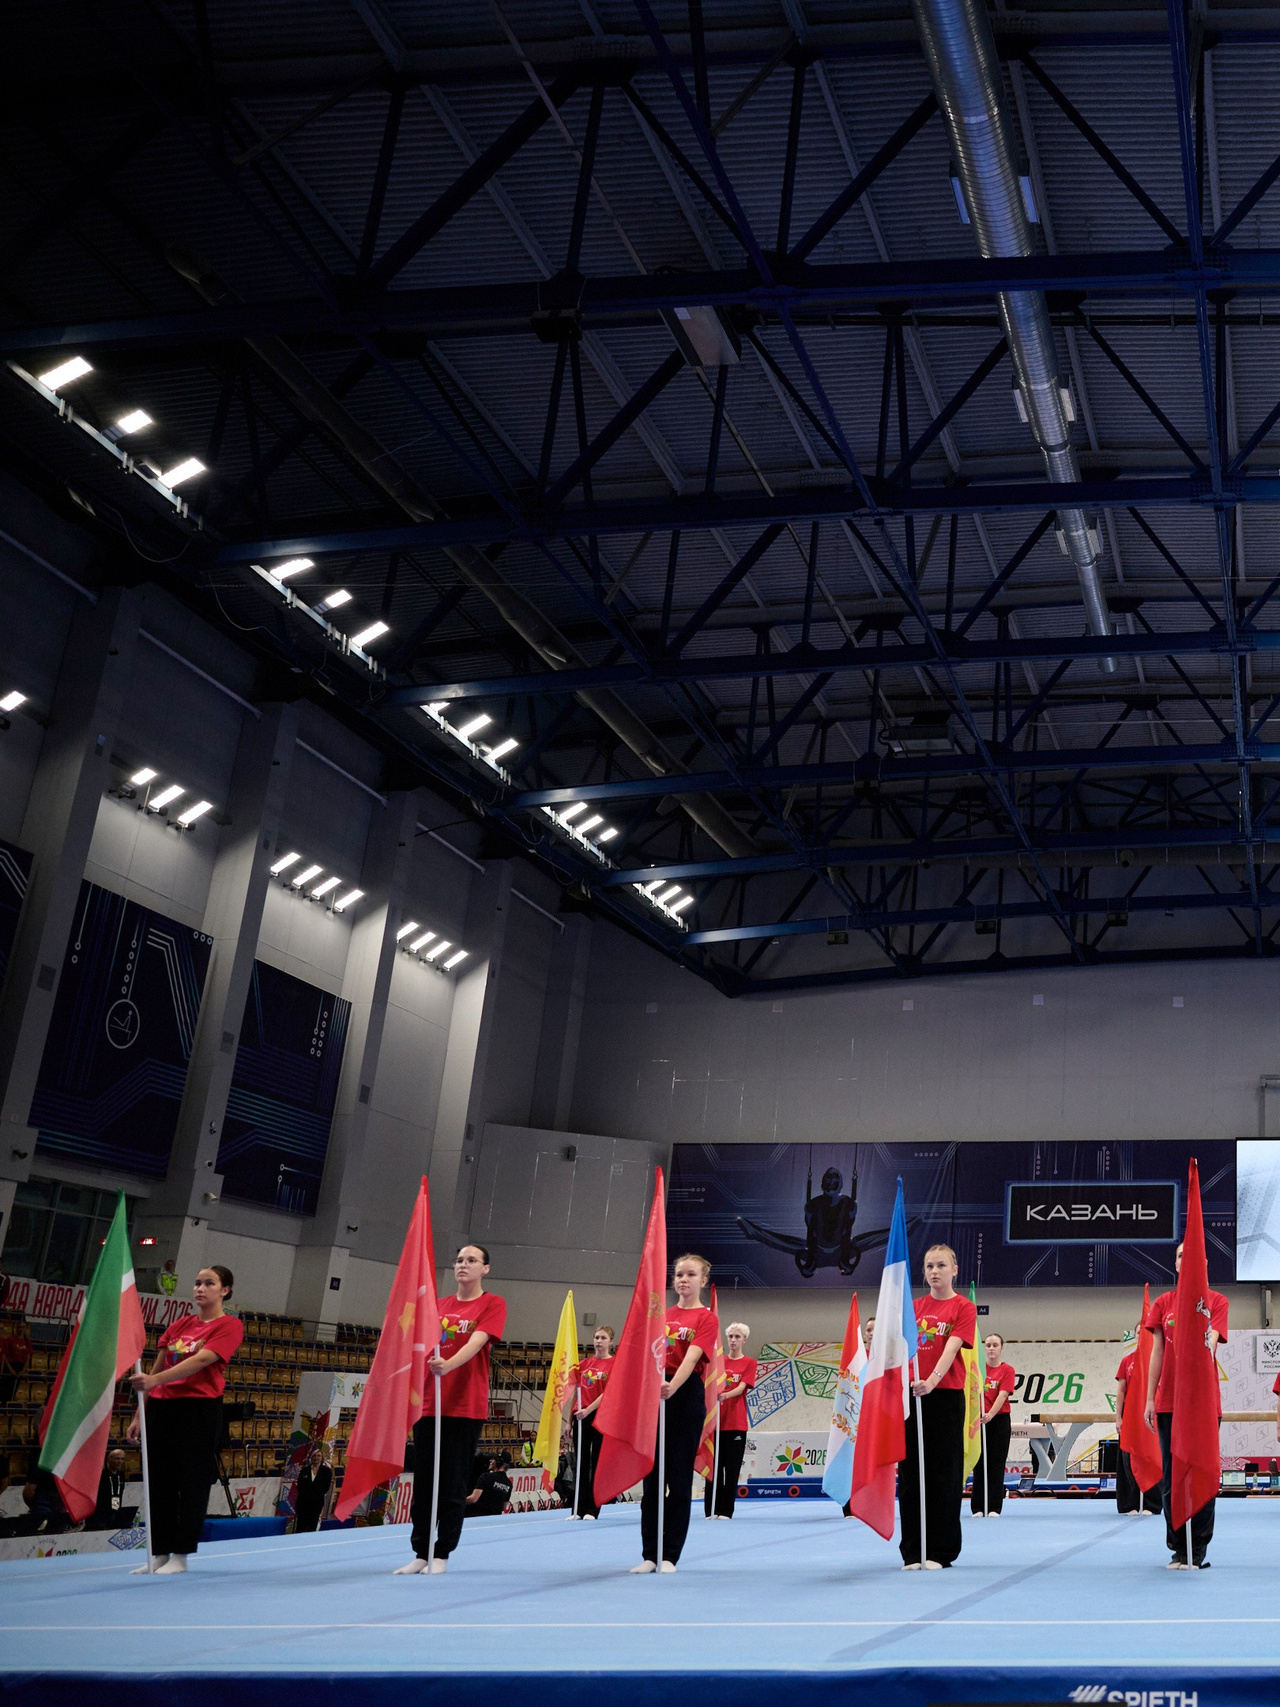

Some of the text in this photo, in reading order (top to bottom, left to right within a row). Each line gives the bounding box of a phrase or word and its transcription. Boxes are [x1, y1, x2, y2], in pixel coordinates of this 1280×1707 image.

[1026, 1203, 1158, 1221] КАЗАНЬ
[32, 1284, 85, 1319] НАРОД
[1009, 1373, 1085, 1404] 2026
